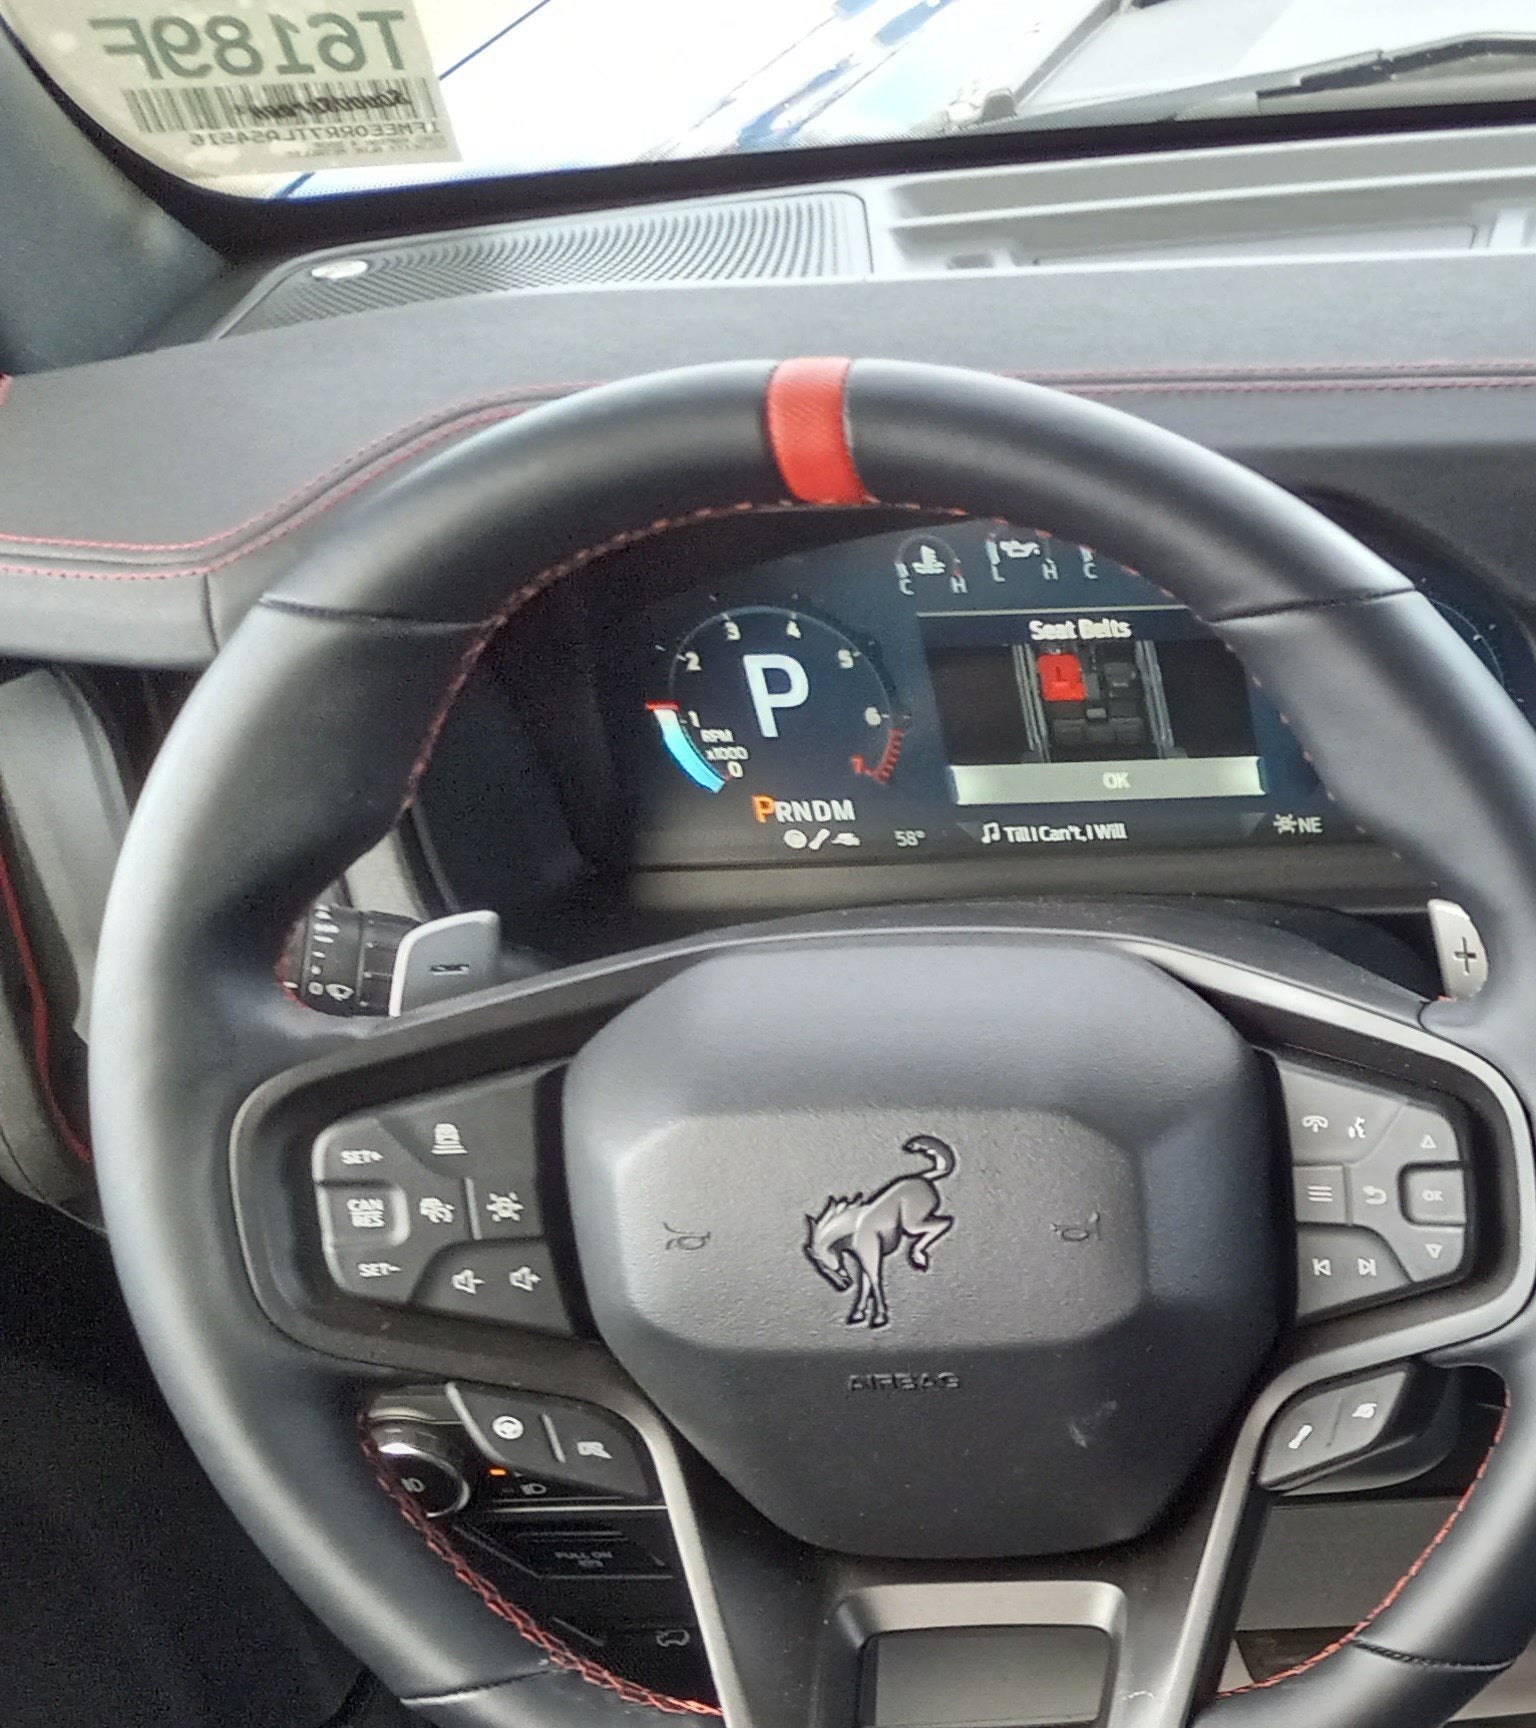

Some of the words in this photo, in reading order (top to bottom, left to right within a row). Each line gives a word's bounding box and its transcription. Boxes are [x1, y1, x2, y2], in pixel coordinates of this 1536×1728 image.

[1042, 563, 1059, 580] H
[899, 578, 915, 595] C
[951, 577, 968, 594] H
[725, 621, 741, 641] 3
[787, 620, 801, 639] 4
[1029, 620, 1078, 640] Seat
[1078, 618, 1132, 640] Belts
[685, 651, 702, 671] 2
[837, 649, 854, 669] 5
[743, 653, 809, 738] P
[688, 710, 701, 728] 1
[864, 706, 882, 726] 6
[700, 729, 734, 743] RPM
[727, 761, 743, 778] 0
[1103, 771, 1131, 789] OK
[1005, 825, 1031, 842] Till
[1093, 823, 1128, 840] Will
[1298, 816, 1322, 834] NE
[1422, 1189, 1444, 1202] OK
[347, 1198, 384, 1212] CAN
